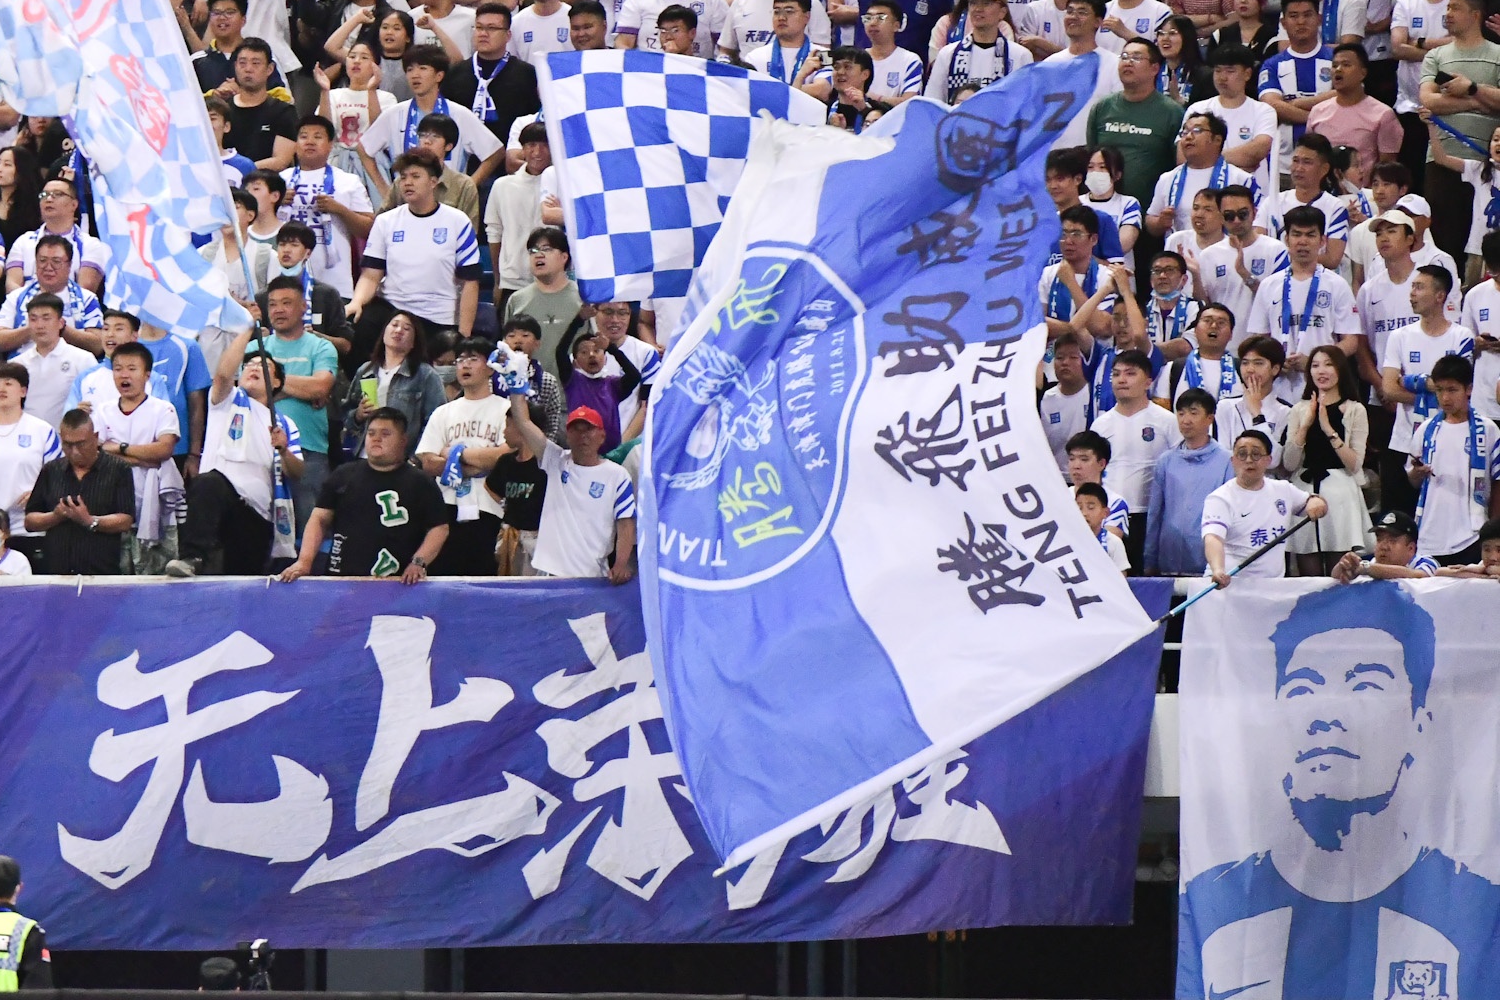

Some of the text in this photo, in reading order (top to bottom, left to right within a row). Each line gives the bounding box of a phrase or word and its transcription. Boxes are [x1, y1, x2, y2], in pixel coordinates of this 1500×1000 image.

[981, 296, 1023, 382] ZHU
[971, 391, 1020, 472] FEI
[505, 481, 535, 500] COPY
[1004, 483, 1104, 620] TENG
